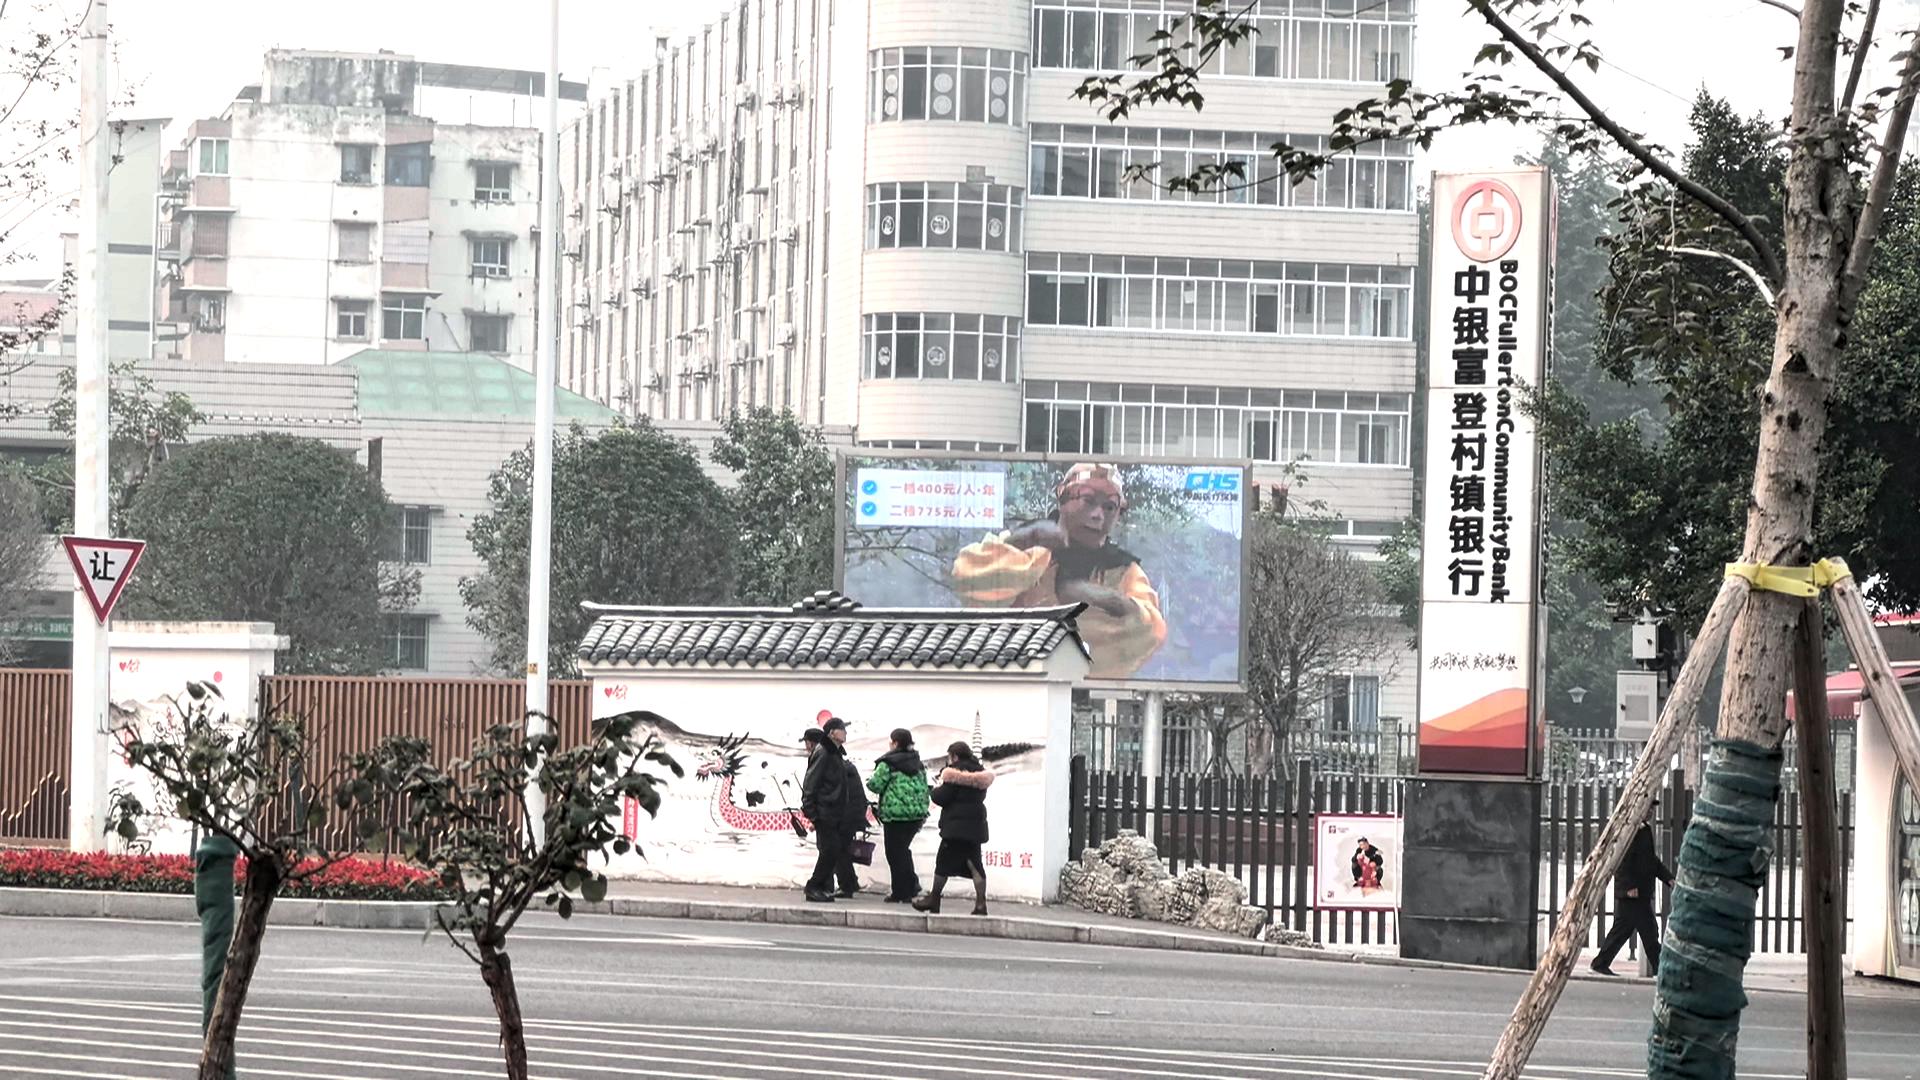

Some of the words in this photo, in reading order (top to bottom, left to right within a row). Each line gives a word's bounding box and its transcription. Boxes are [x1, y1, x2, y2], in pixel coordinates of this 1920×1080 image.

[1448, 265, 1490, 596] 中银富登村镇银行
[89, 551, 115, 581] 让
[981, 850, 1012, 868] 街道
[1020, 852, 1033, 868] 宣
